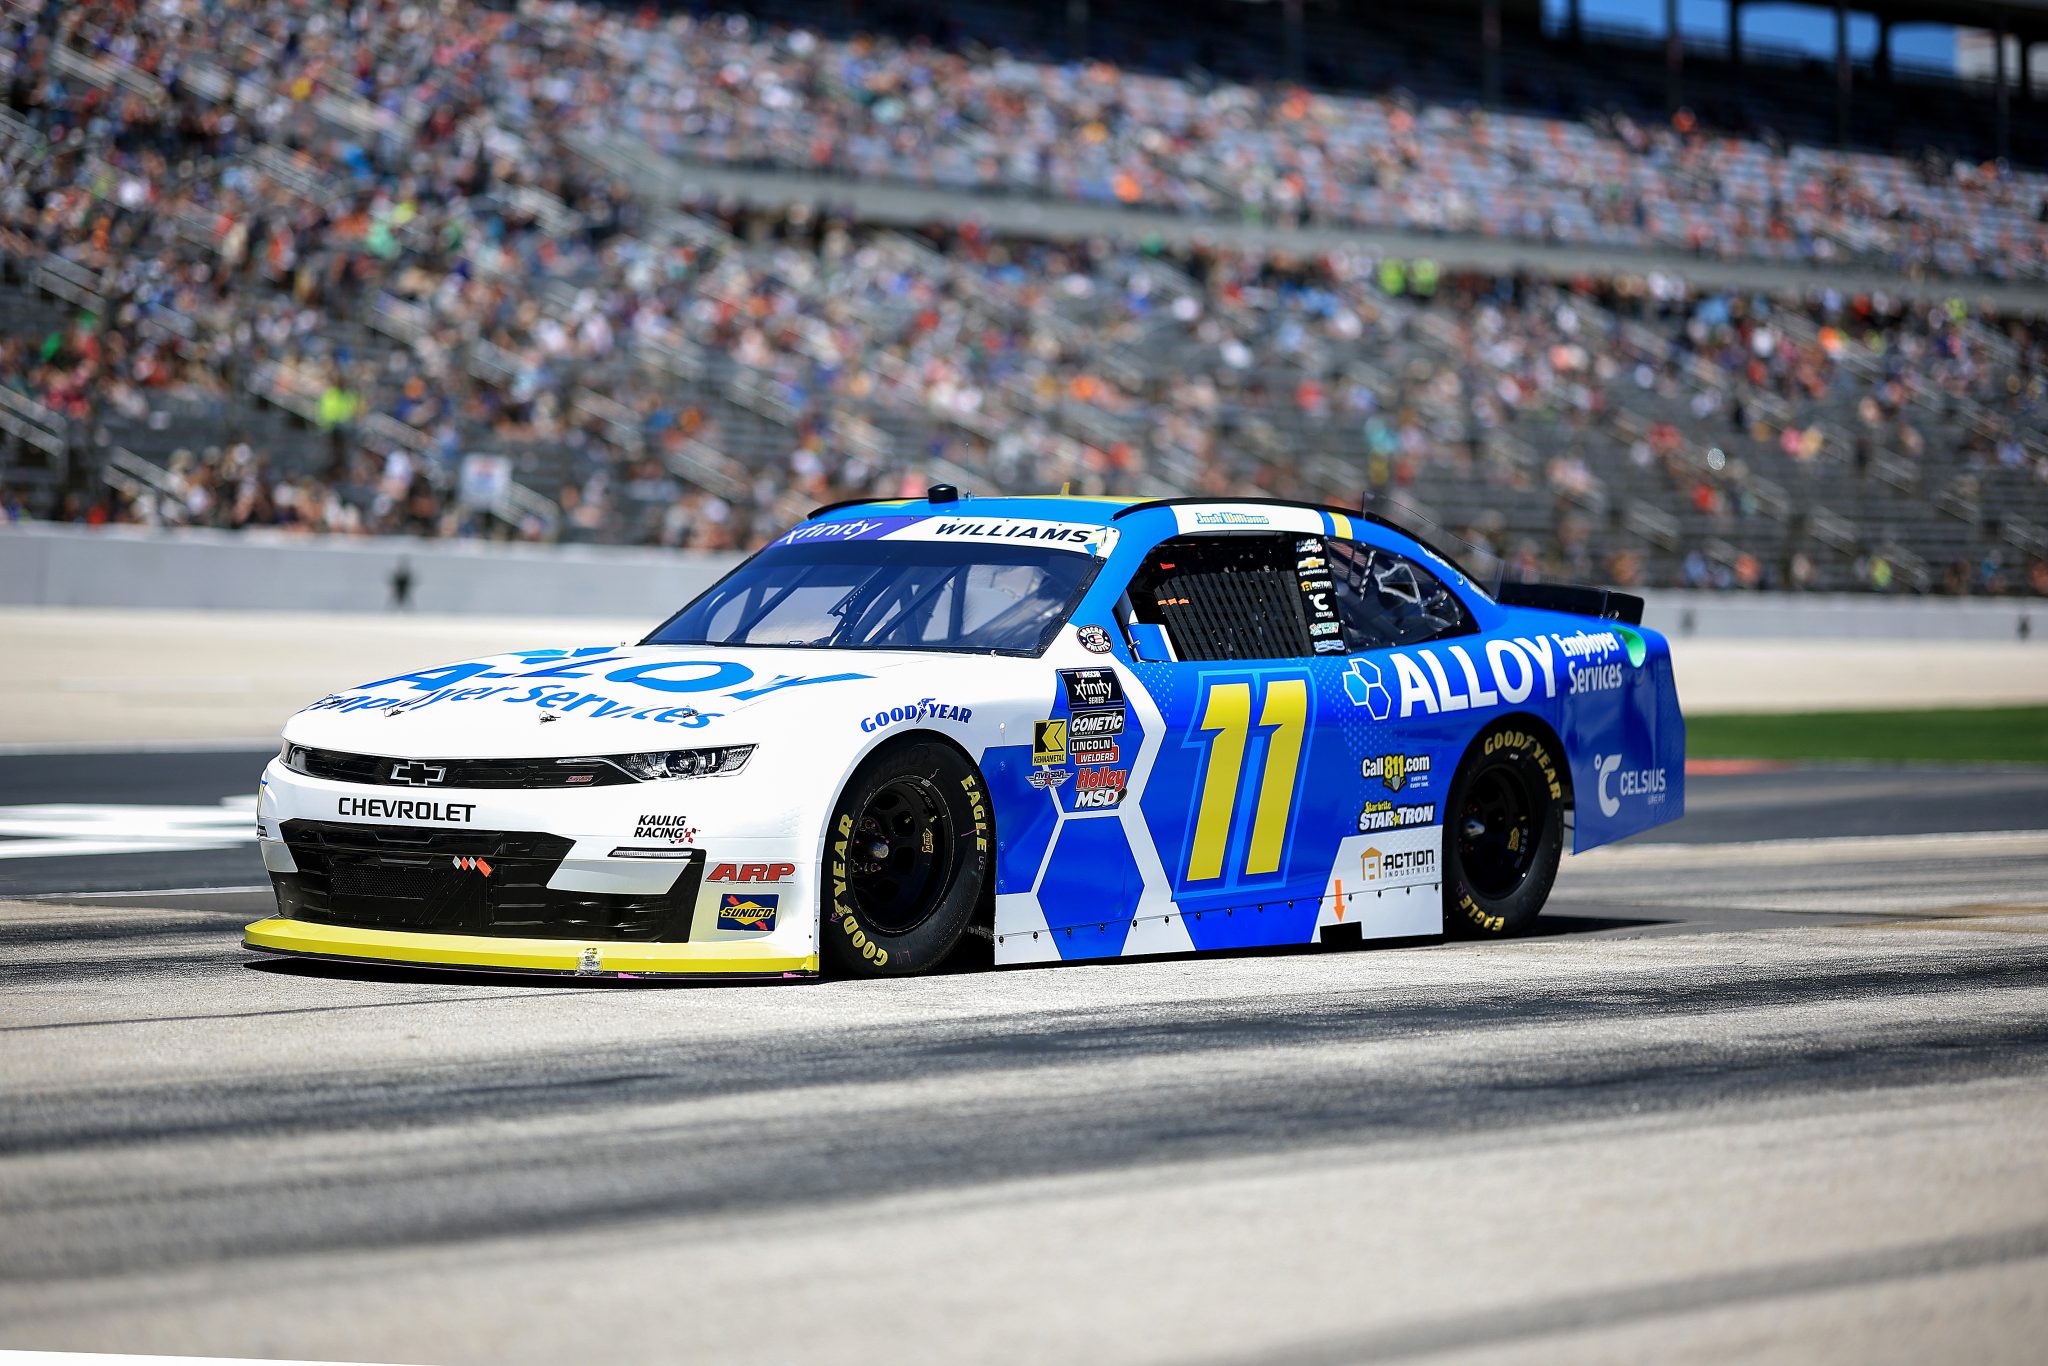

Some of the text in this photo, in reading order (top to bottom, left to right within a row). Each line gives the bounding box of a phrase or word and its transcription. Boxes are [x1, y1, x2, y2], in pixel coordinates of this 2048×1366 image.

[778, 520, 883, 544] xfinity
[936, 524, 1091, 543] WILLIAMS
[1551, 630, 1619, 662] Employer
[1390, 635, 1556, 718] ALLOY
[1568, 656, 1622, 694] Services
[1074, 679, 1112, 700] xfinity
[1088, 696, 1105, 704] SERIES
[1071, 715, 1123, 732] COMETIC
[1071, 740, 1111, 752] LINCOLN
[1080, 753, 1115, 763] WELDERS
[1076, 766, 1126, 792] Holley
[1186, 679, 1307, 881] 11
[1620, 768, 1666, 796] CELSIUS
[338, 797, 476, 822] CHEVROLET
[1074, 790, 1120, 808] MSD
[638, 815, 686, 826] KAULIG
[961, 775, 987, 853] EAGLE
[634, 827, 684, 839] RACING
[1383, 849, 1435, 870] ACTION
[706, 863, 796, 881] ARP
[1385, 865, 1436, 878] INDUSTRIES
[722, 908, 773, 918] SUNOCO
[1458, 895, 1505, 932] EAGLE
